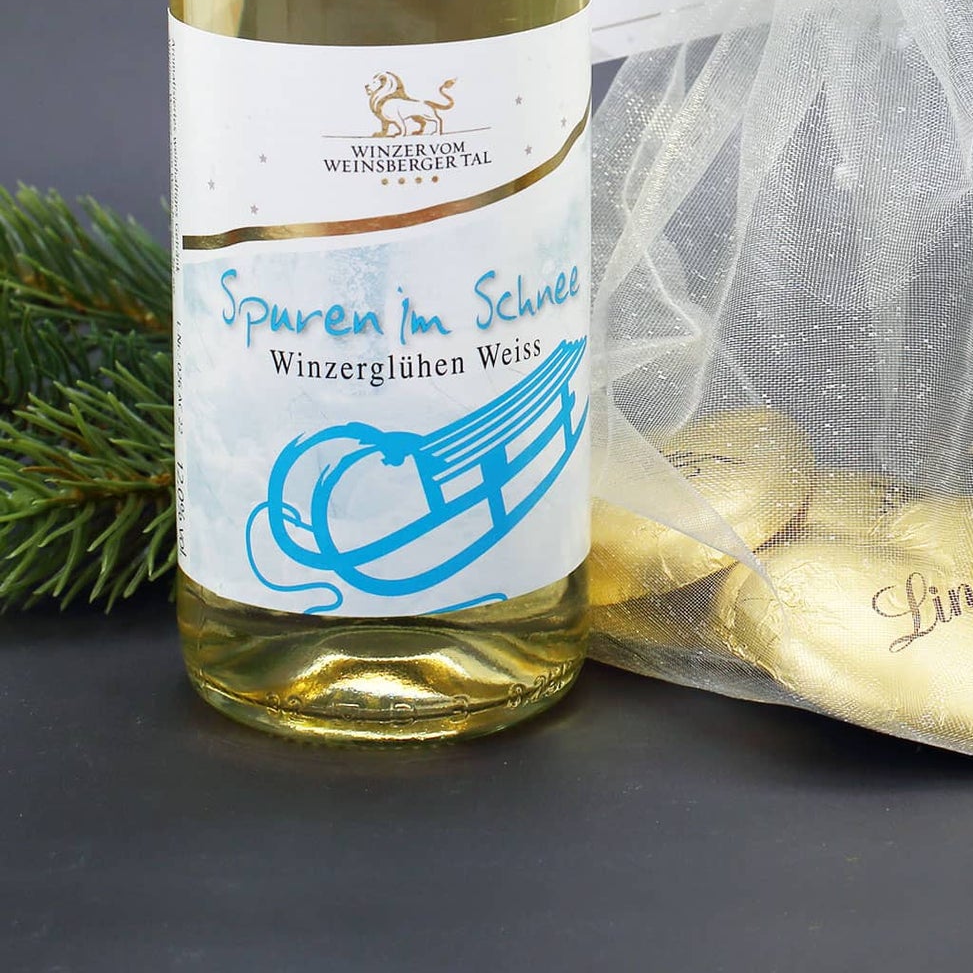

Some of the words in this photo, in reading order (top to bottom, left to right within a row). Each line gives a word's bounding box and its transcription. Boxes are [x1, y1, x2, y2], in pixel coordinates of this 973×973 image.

[323, 156, 457, 174] WEINSBERGER
[460, 151, 493, 167] TAL
[350, 143, 425, 159] WINZER
[430, 140, 466, 155] VOM
[219, 268, 385, 349] Spuren
[397, 286, 452, 346] im
[473, 264, 581, 330] Schnee
[269, 348, 466, 387] Winzerglühen
[476, 336, 542, 370] Weiss
